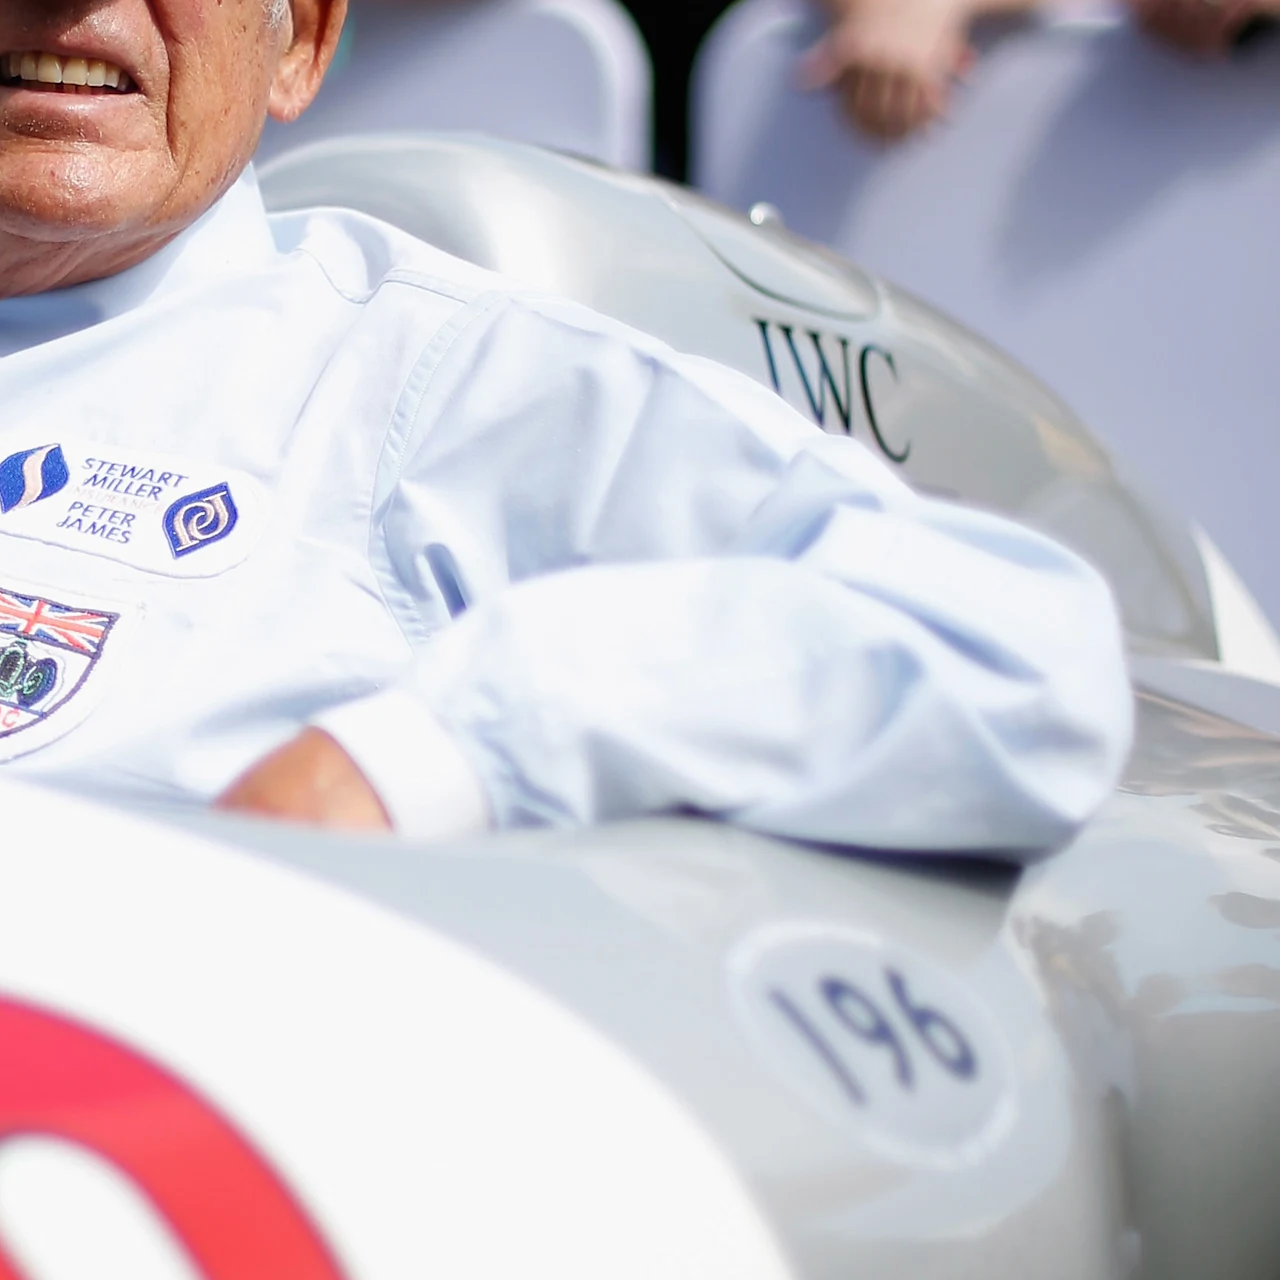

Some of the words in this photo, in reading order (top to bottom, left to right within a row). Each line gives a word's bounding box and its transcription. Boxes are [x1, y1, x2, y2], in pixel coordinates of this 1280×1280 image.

[751, 317, 912, 463] IWC
[81, 457, 189, 488] STEWART
[82, 473, 164, 501] MILLER
[67, 500, 136, 528] PETER
[56, 515, 132, 544] JAMES
[766, 964, 977, 1106] 196
